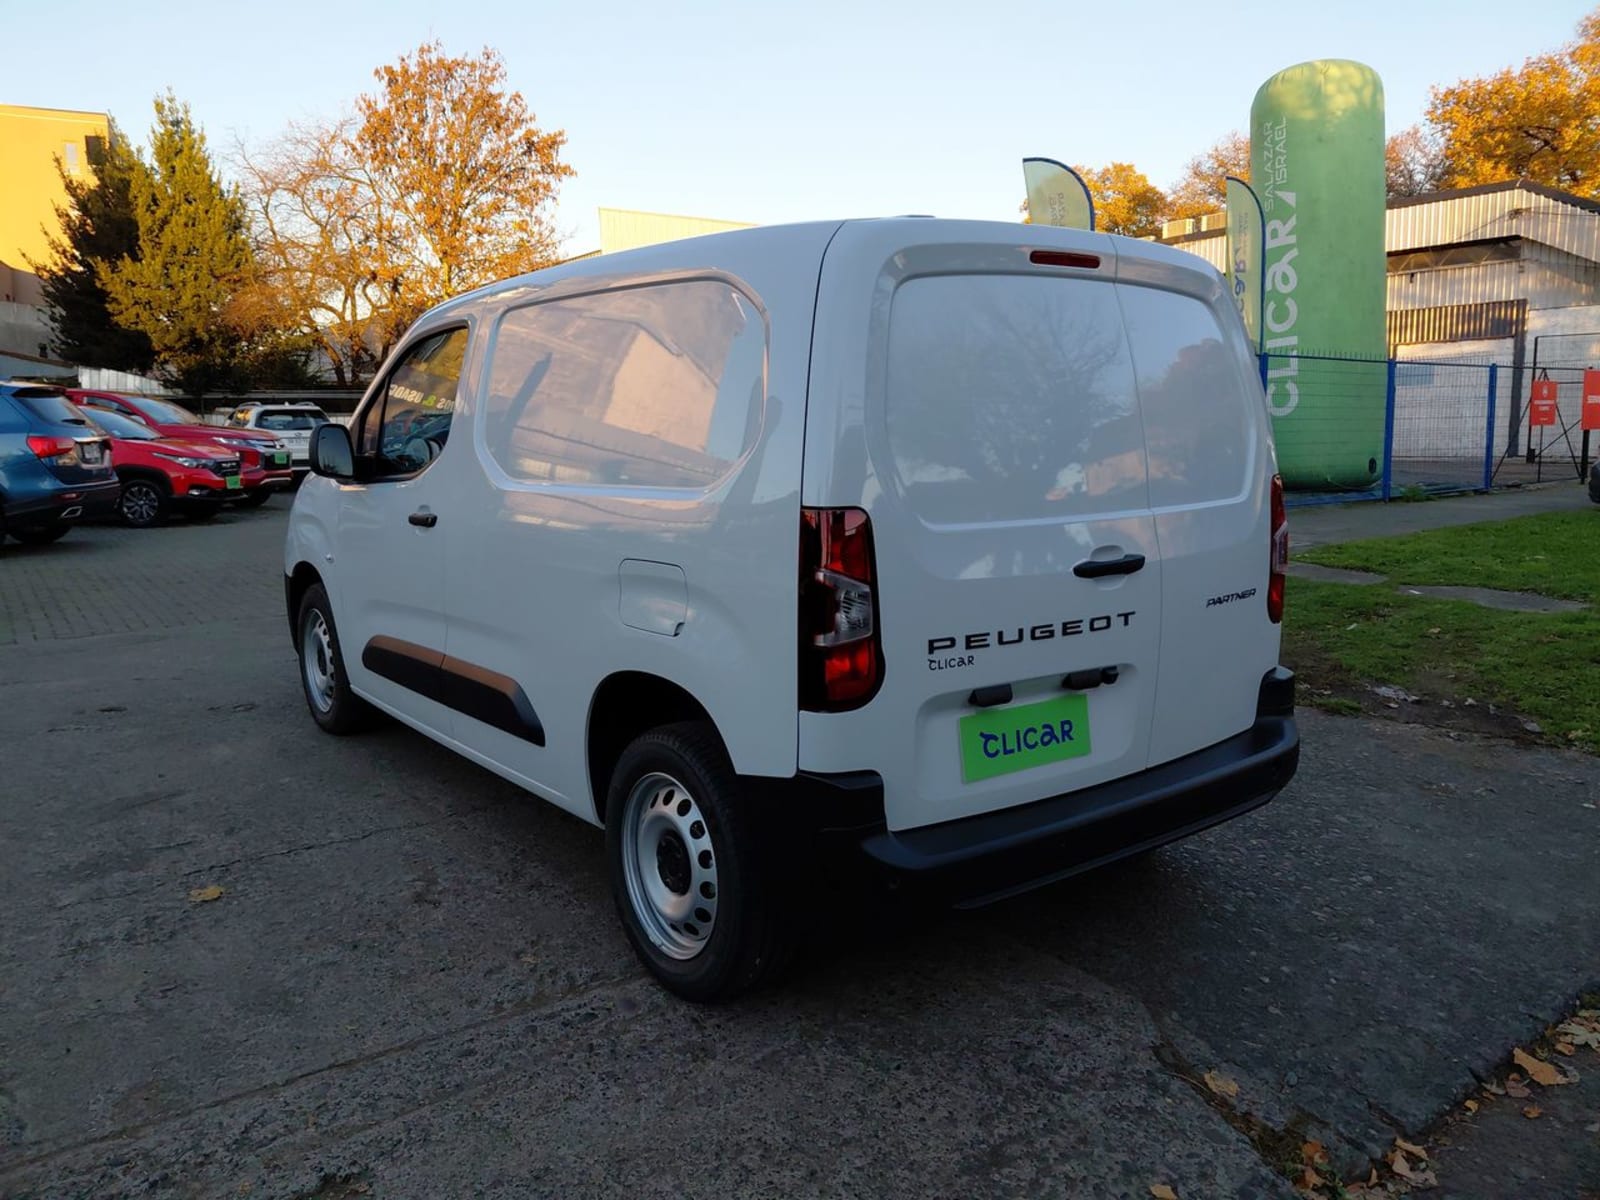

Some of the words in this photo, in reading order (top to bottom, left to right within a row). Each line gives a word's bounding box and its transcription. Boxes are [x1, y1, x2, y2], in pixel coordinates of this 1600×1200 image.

[1263, 121, 1274, 211] SALAZAR
[1275, 115, 1288, 184] ISRAEL
[1206, 588, 1257, 608] PARTNER
[928, 611, 1136, 655] PEUGEOT
